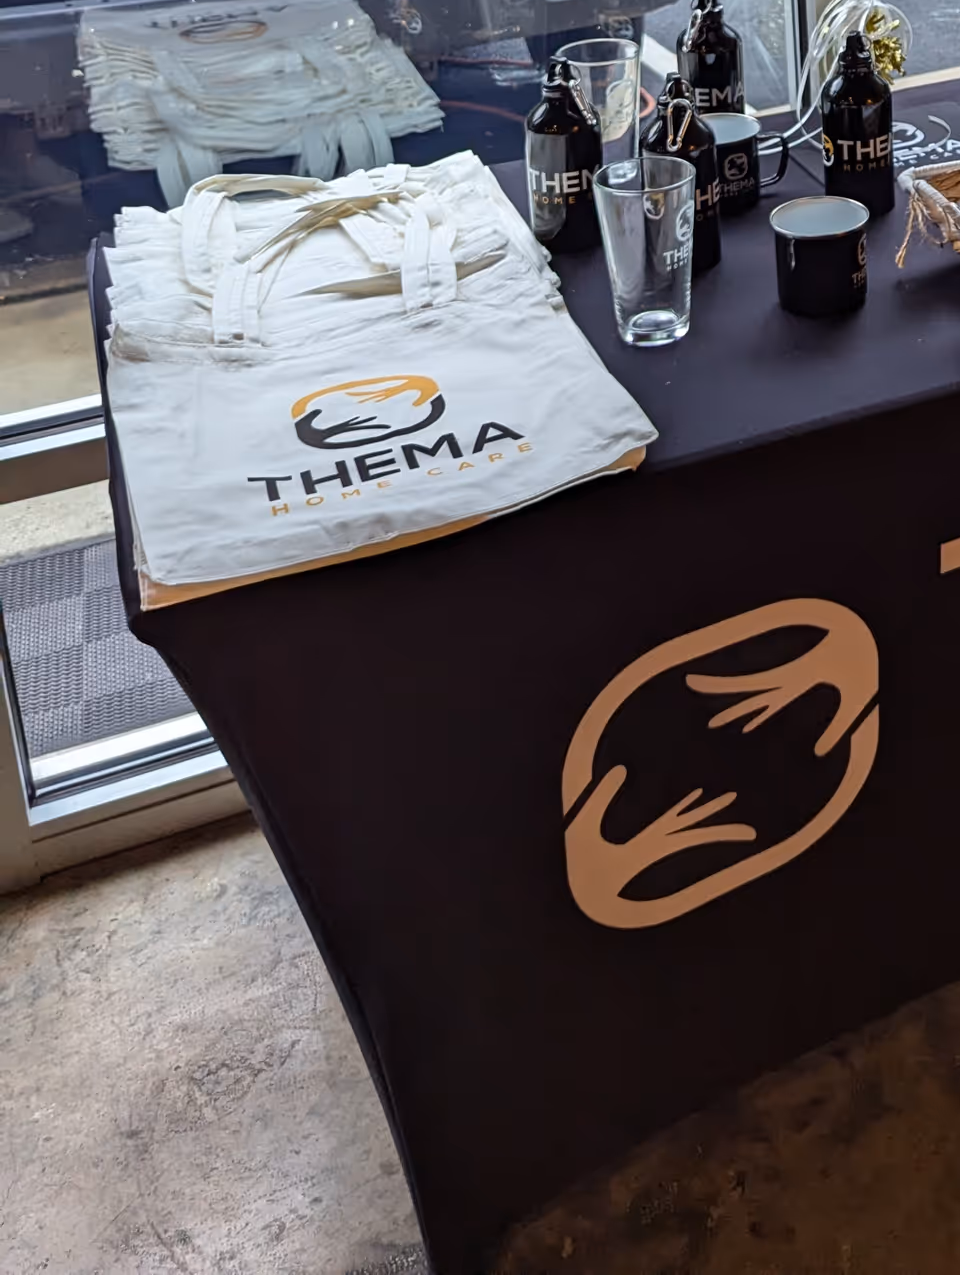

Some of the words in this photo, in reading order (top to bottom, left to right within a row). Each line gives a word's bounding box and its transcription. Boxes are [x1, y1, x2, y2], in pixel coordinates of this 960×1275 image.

[696, 82, 744, 107] EMA
[837, 135, 892, 161] THE
[663, 243, 693, 264] THE
[247, 421, 526, 502] THEMA
[271, 479, 394, 517] HOME
[426, 442, 535, 477] CARE
